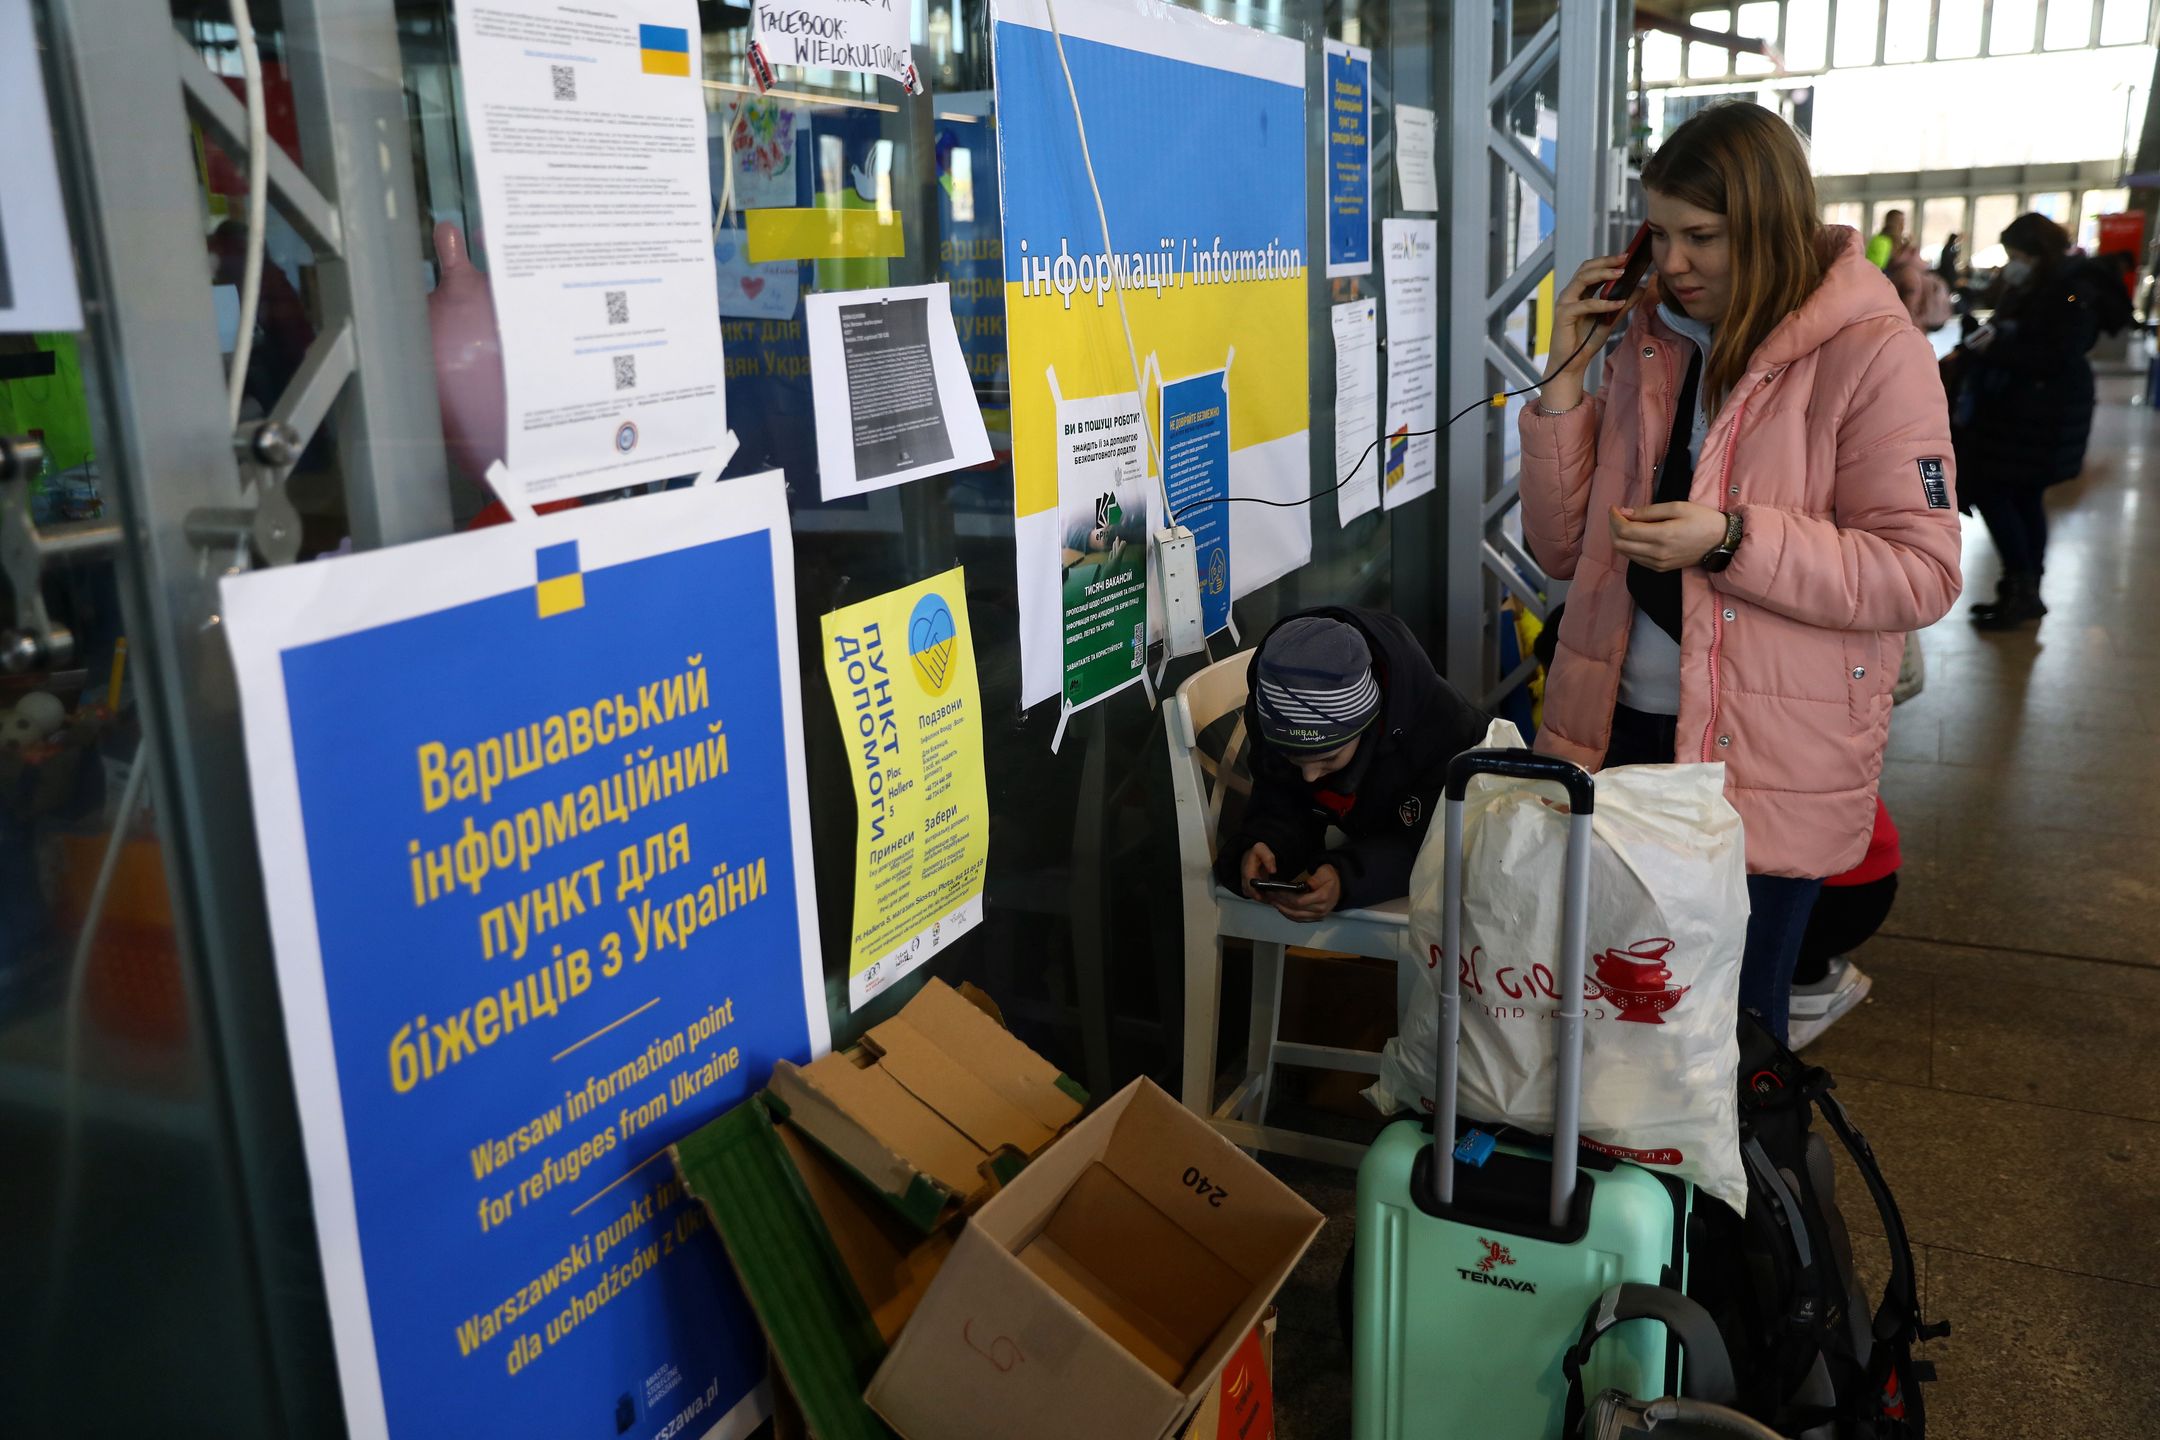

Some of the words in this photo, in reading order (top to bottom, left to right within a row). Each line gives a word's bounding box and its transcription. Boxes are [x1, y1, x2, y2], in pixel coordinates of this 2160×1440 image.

[758, 4, 848, 40] FACEBOOK:
[1021, 237, 1175, 309] інформації
[1192, 237, 1301, 285] information
[1064, 423, 1076, 436] ВИ
[1078, 422, 1084, 434] В
[1085, 418, 1113, 433] ПОШУЦІ
[1114, 412, 1141, 428] РОБОТИ?
[1103, 438, 1110, 447] ЗА
[863, 622, 899, 754] ПУНКТ
[417, 653, 710, 813] Варшавський
[918, 697, 963, 730] Подзвони
[1289, 729, 1319, 737] URBAN
[834, 635, 885, 842] ДОПОМОГИ
[1301, 733, 1326, 742] Jungle
[887, 767, 901, 782] Plac
[409, 721, 730, 907] інформаційний
[889, 804, 895, 818] 5
[924, 803, 958, 833] Забери
[870, 829, 915, 865] Принеси
[478, 859, 605, 961] пункт
[617, 822, 692, 901] для
[915, 888, 938, 905] Siostry
[389, 944, 593, 1094] біженців
[601, 931, 623, 976] з
[628, 857, 768, 962] України
[471, 1108, 563, 1181] Warsaw
[567, 1030, 686, 1124] information
[686, 997, 735, 1054] point
[477, 1192, 515, 1234] for
[520, 1124, 616, 1208] refugees
[619, 1098, 668, 1143] from
[670, 1045, 740, 1108] Ukraine
[1183, 1167, 1229, 1207] 240
[456, 1235, 593, 1358] Warszawski
[596, 1192, 654, 1251] punkt
[1457, 1268, 1537, 1295] TENAYA
[507, 1332, 543, 1377] dla
[546, 1242, 660, 1347] uchodźców
[664, 1224, 675, 1255] z
[650, 1376, 719, 1440] rszawa.pl
